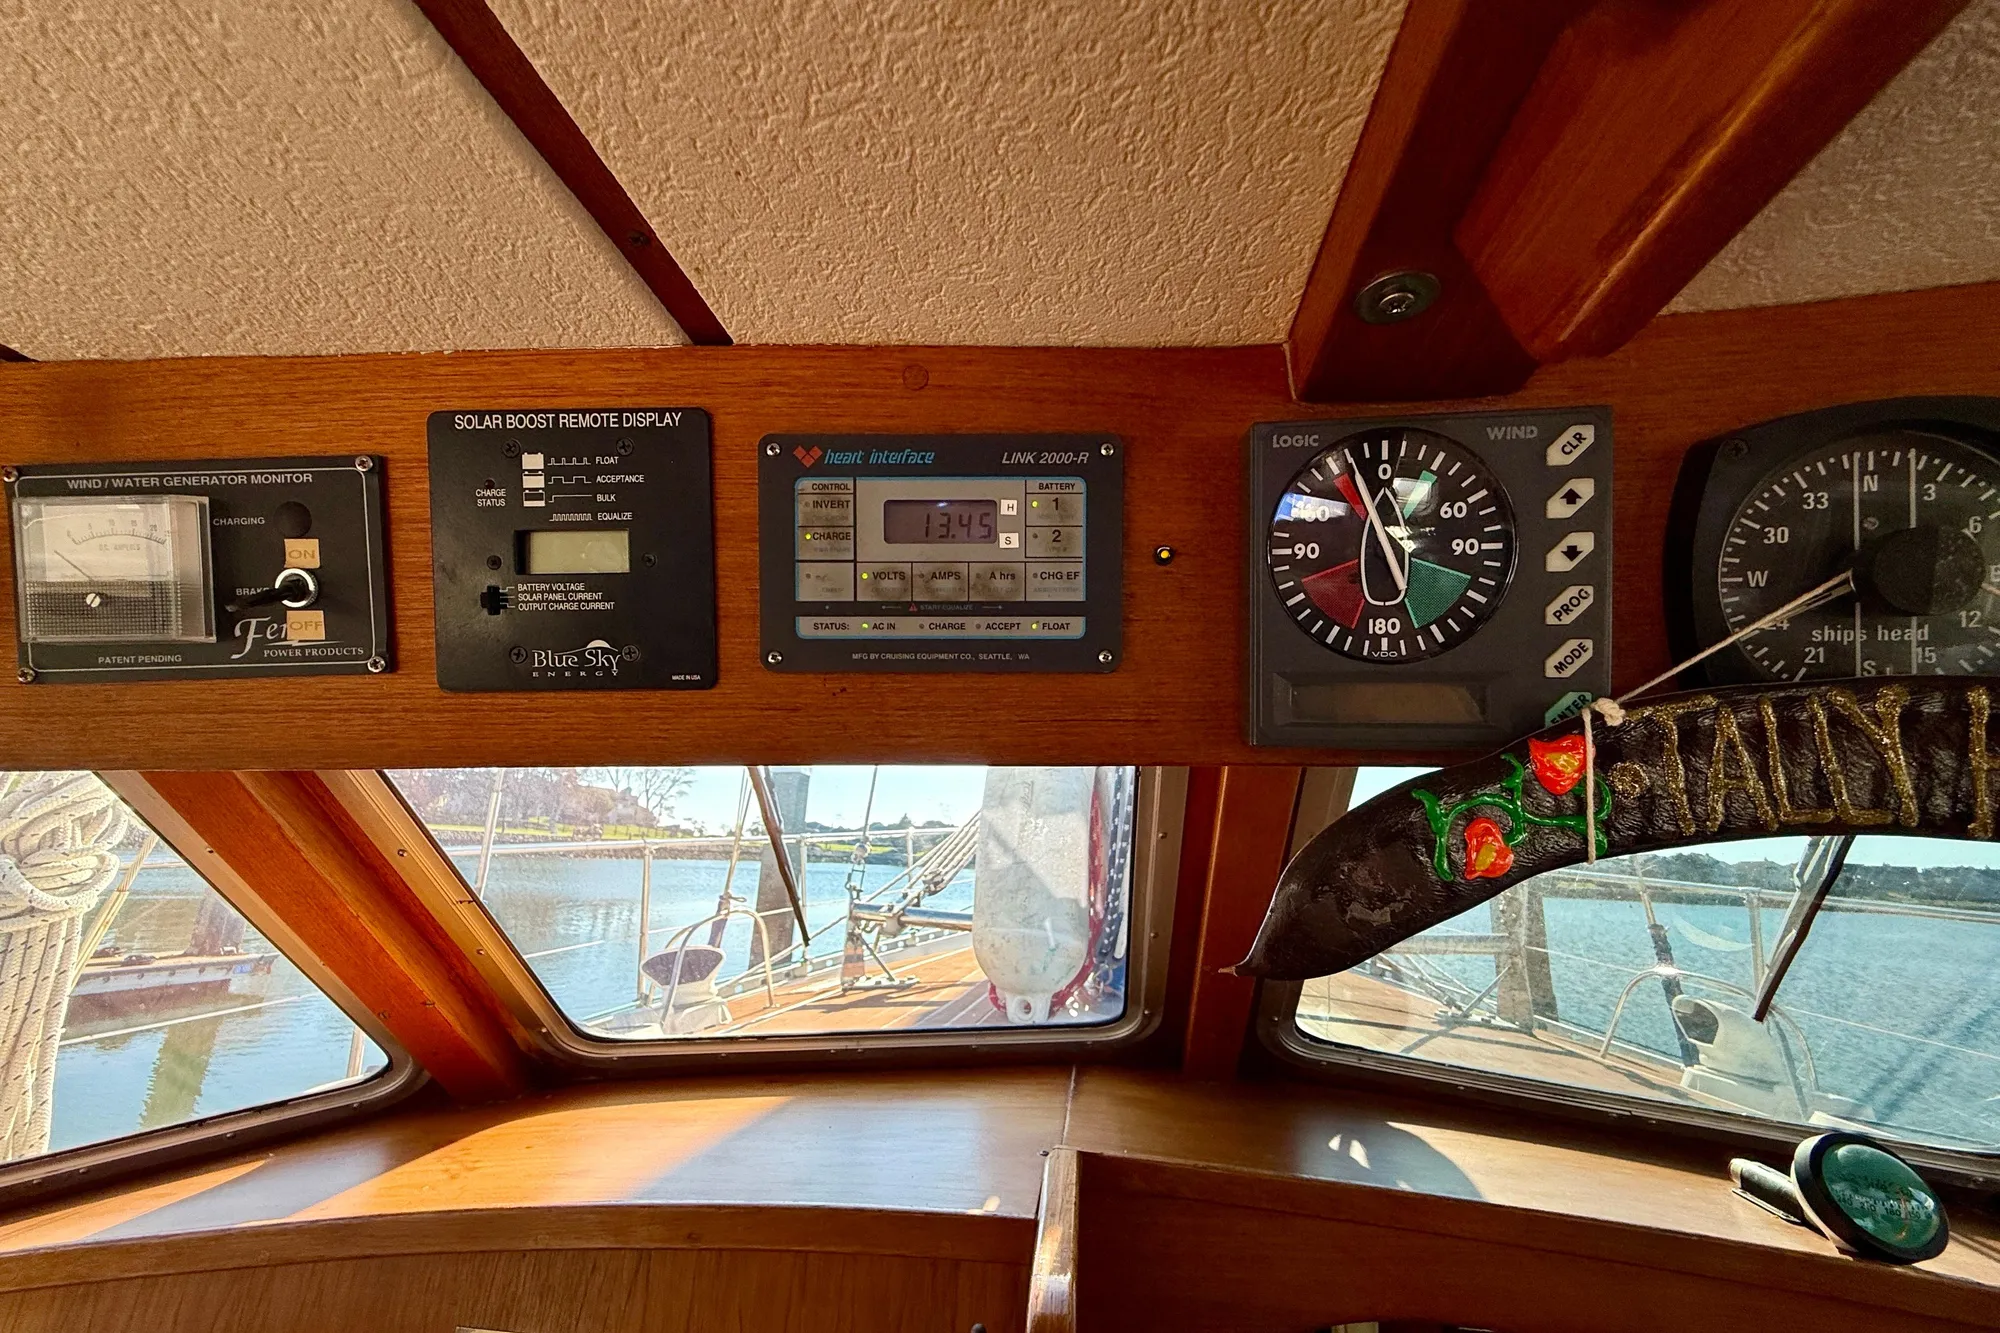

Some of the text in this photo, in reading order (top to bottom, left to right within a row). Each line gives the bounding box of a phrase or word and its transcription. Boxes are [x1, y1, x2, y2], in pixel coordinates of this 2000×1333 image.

[454, 411, 682, 430] SOLAR BOOST REMOTE DISPLAY
[1486, 425, 1539, 441] WIND
[1272, 434, 1319, 448] LOGIC
[1560, 431, 1588, 456] CLR
[595, 456, 619, 465] FLOAT
[824, 448, 936, 465] heart interface
[1002, 451, 1090, 464] LINK 2000-R
[1377, 463, 1392, 481] 0
[67, 479, 101, 490] WIND
[111, 477, 161, 488] WATER
[163, 475, 248, 487] GENERATOR
[251, 473, 313, 485] MONITOR
[596, 474, 645, 484] ACCEPTANCE
[1862, 474, 1879, 492] N
[475, 488, 507, 497] CHARGE
[811, 482, 851, 491] CONTROL
[1038, 482, 1076, 491] BATTERY
[1923, 483, 1936, 501] 3
[477, 498, 506, 507] STATUS
[596, 493, 616, 502] BULK
[1802, 492, 1829, 510] 33
[812, 500, 851, 509] INVERT
[1006, 503, 1014, 512] H
[1052, 497, 1059, 511] 1
[1439, 501, 1468, 519] 60
[213, 516, 265, 527] CHARGING
[597, 512, 633, 521] EQUALIZE
[924, 512, 993, 540] 13.45
[1968, 515, 1982, 534] 6
[812, 531, 852, 541] CHARGE
[1004, 536, 1012, 545] S
[1051, 529, 1062, 543] 2
[1763, 526, 1789, 544] 30
[1293, 543, 1320, 560] 90
[1451, 538, 1479, 556] 90
[288, 549, 316, 560] ON
[872, 571, 906, 580] VOLTS
[930, 571, 961, 581] AMPS
[989, 571, 1016, 580] A hrs
[1039, 571, 1081, 581] CHG EF
[1747, 570, 1768, 587] W
[236, 587, 270, 596] BRA
[517, 582, 586, 592] BATTERY VOLTAGE
[518, 592, 603, 601] SOLAR PANEL CURRENT
[518, 601, 615, 611] OUTPUT CHARGE CURRENT
[1552, 588, 1590, 622] PROG
[1958, 610, 1983, 629] 12
[289, 620, 323, 632] OFF
[813, 622, 896, 631] STATUS: AC IN
[928, 622, 966, 631] CHARGE
[985, 622, 1021, 631] ACCEPT
[1042, 622, 1071, 630] FLOAT
[1367, 618, 1401, 635] 180
[1811, 624, 1930, 645] ships head
[263, 647, 364, 657] POWER PRODUCTS
[1371, 650, 1398, 658] VDO
[1553, 641, 1589, 675] MODE
[1804, 647, 1825, 664] 21
[1916, 646, 1937, 664] 15
[98, 654, 182, 664] PATENT PENDING
[531, 649, 621, 671] Blue Sky
[532, 669, 619, 678] ENERGY
[1862, 659, 1877, 677] S
[1624, 685, 1920, 837] TALLY
